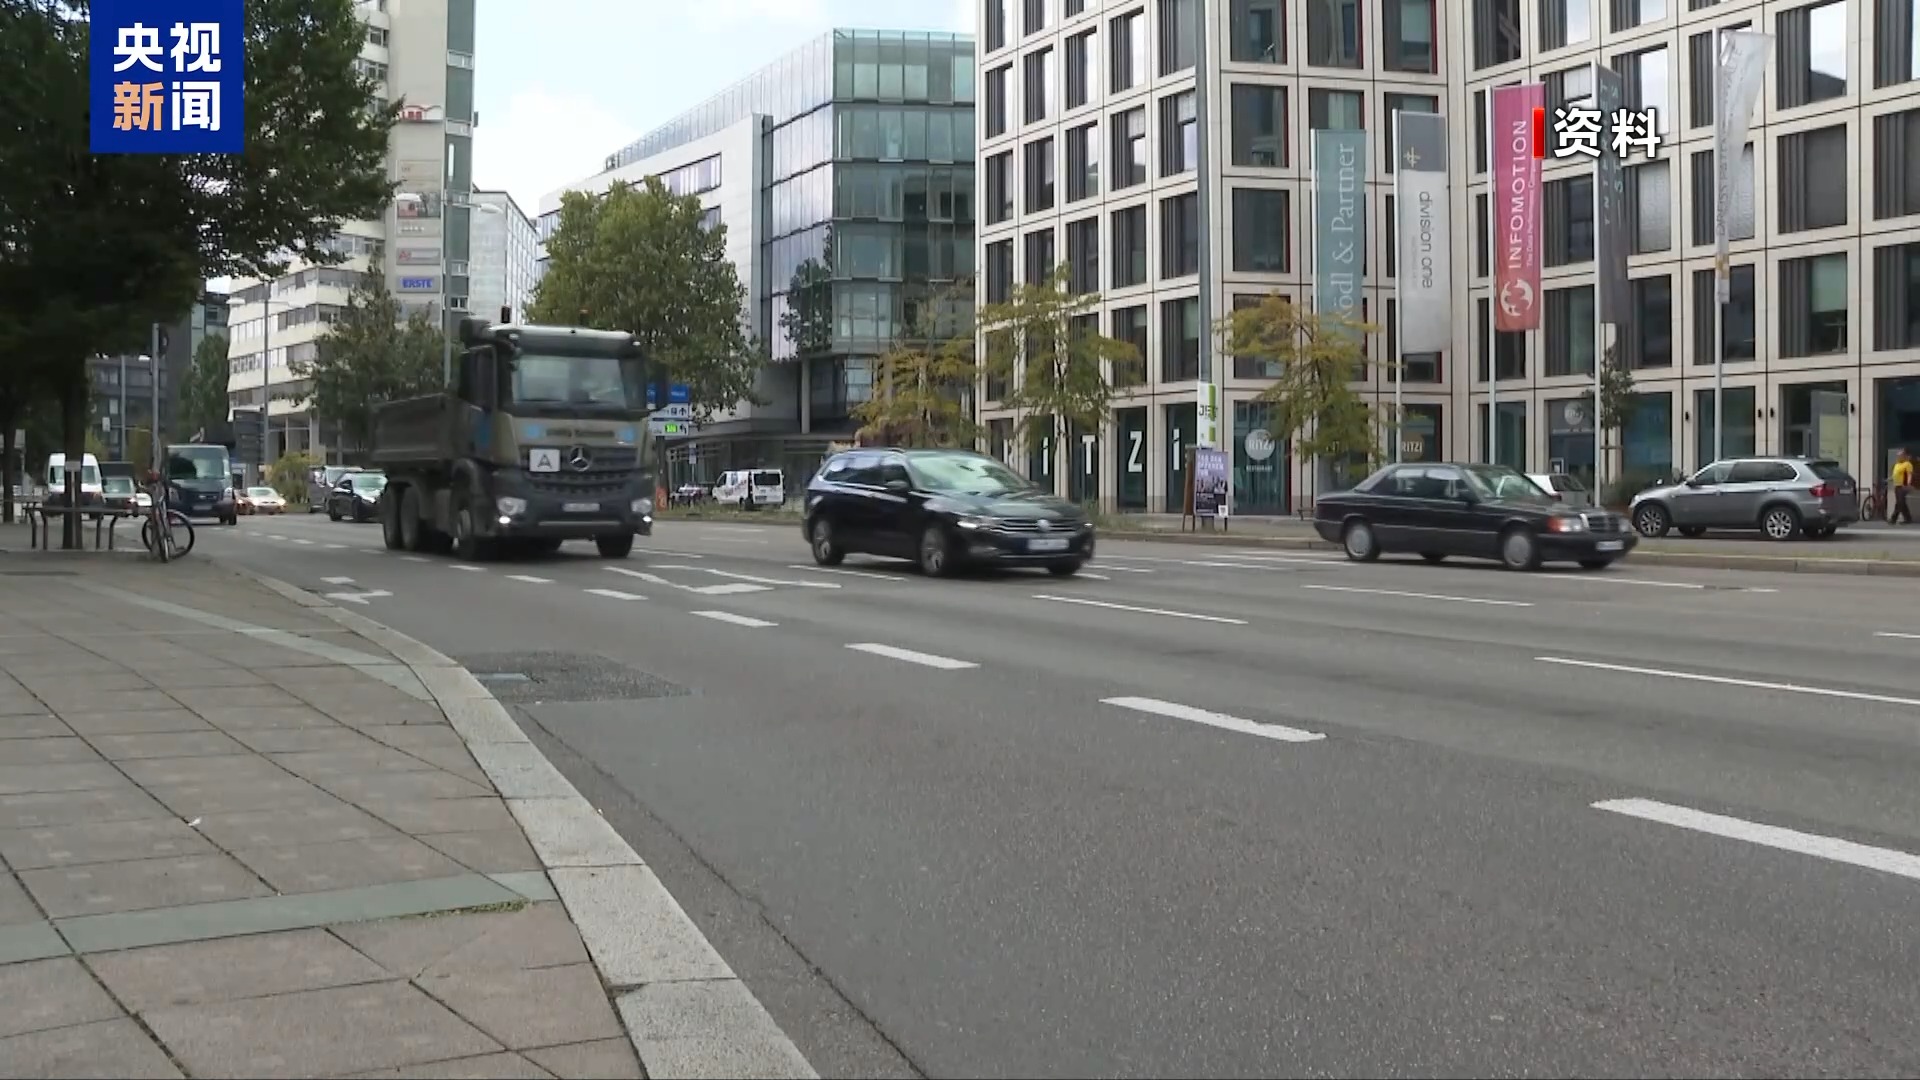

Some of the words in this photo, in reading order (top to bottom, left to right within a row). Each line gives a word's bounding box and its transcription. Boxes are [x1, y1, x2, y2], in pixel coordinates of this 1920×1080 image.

[1331, 143, 1354, 233] Partner
[1508, 120, 1527, 269] INFOMOTION
[1419, 191, 1434, 252] division
[1331, 243, 1354, 263] &
[537, 454, 552, 469] A
